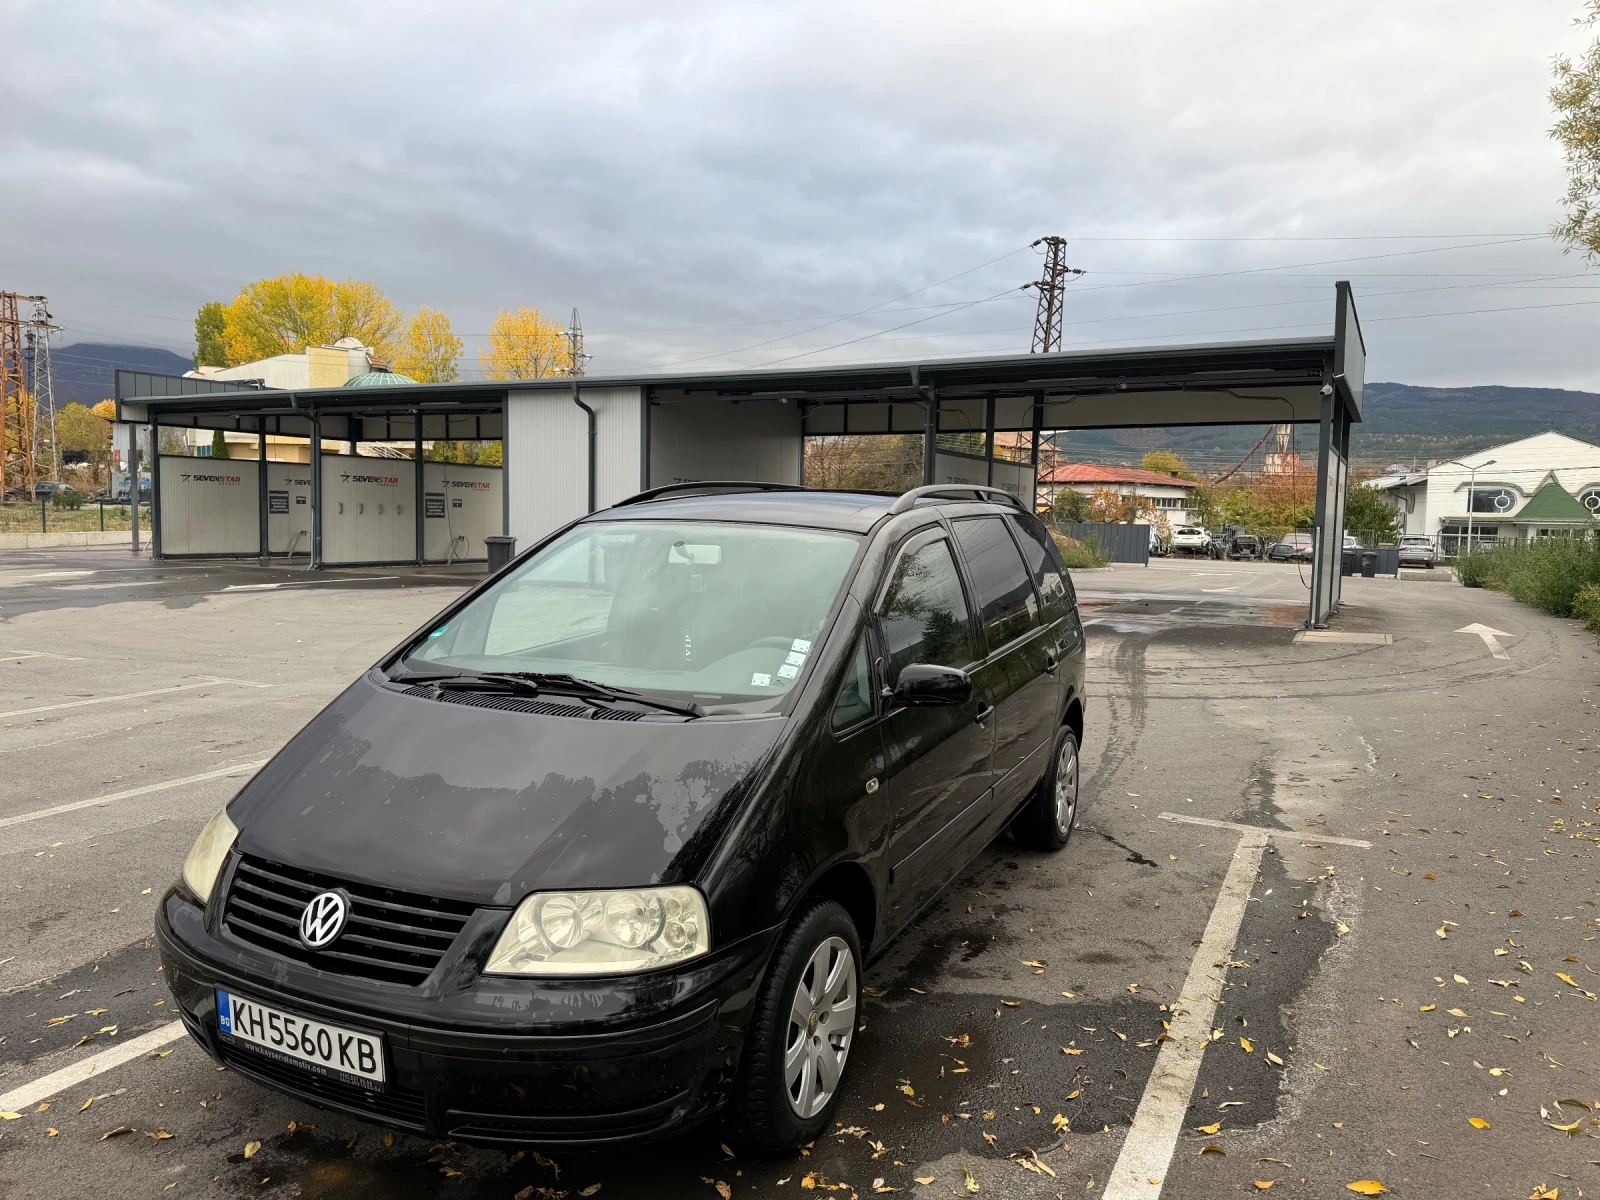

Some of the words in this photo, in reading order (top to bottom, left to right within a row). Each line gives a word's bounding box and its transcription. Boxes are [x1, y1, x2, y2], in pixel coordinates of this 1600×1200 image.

[193, 474, 241, 483] SEVENSTAR
[352, 475, 399, 484] SEVENSTAR
[451, 481, 490, 489] SEVENSTAR
[220, 1014, 231, 1027] BG
